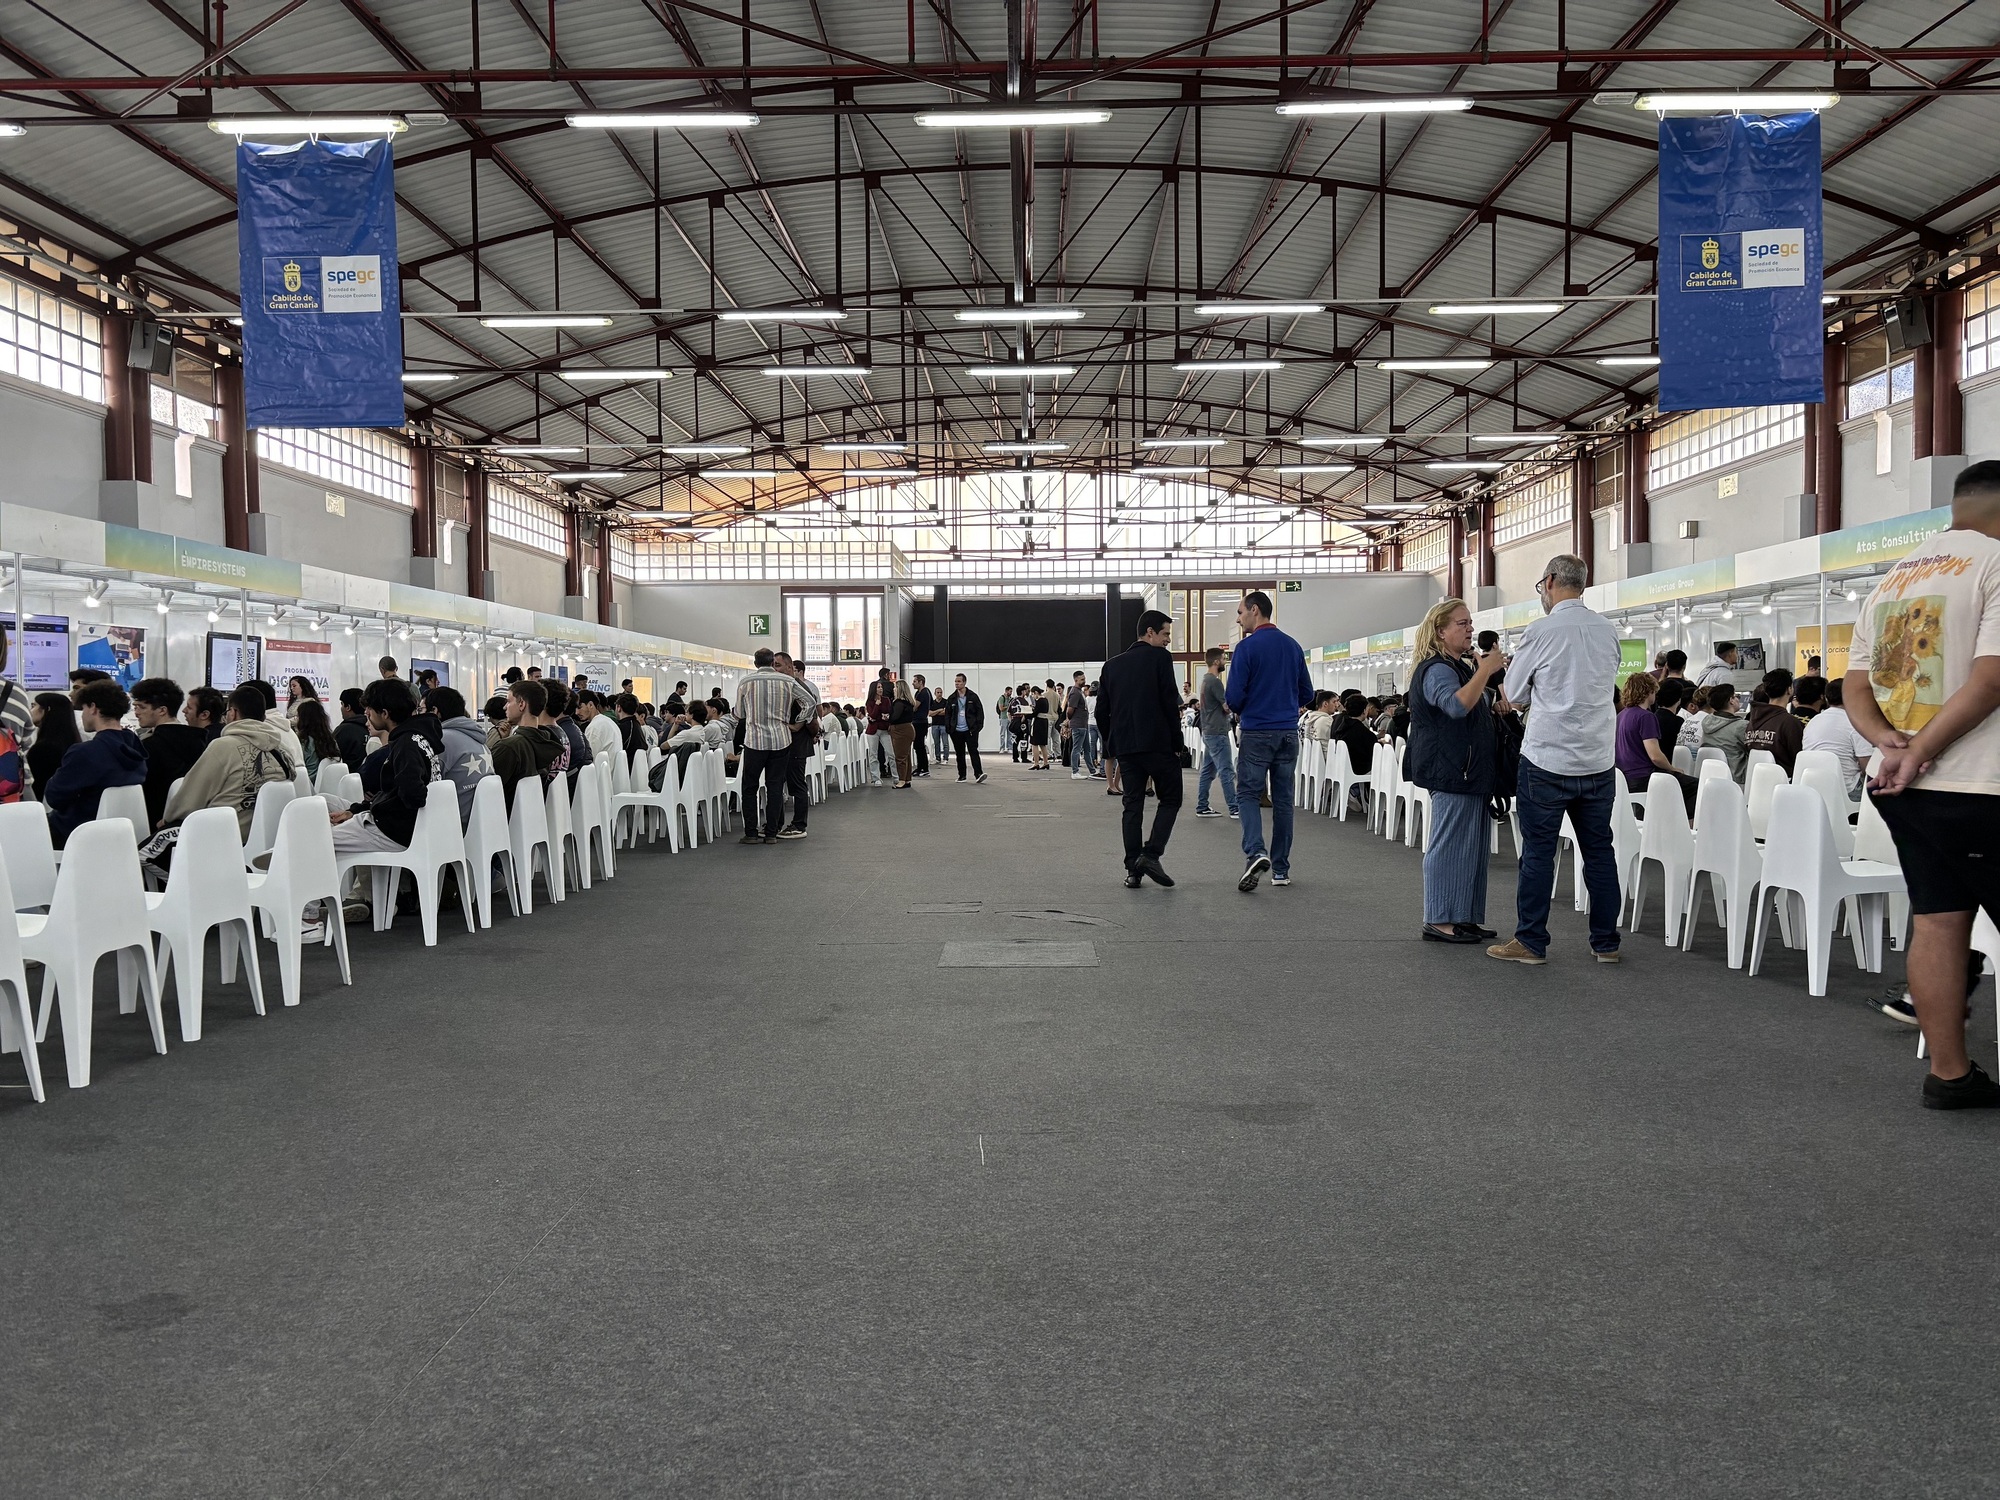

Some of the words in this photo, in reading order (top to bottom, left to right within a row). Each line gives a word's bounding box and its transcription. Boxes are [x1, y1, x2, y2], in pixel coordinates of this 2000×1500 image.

[1748, 243, 1799, 258] spegc
[327, 270, 375, 284] spegc
[1689, 271, 1720, 279] Cabildo
[1721, 270, 1732, 278] de
[1686, 279, 1705, 287] Gran
[1706, 278, 1737, 286] Canaria
[272, 294, 302, 302] Cabildo
[289, 301, 319, 309] Canaria
[1856, 541, 1877, 554] Atos
[181, 555, 246, 578] EMPIRESYSTEMS
[1920, 557, 1934, 567] Van
[1677, 579, 1695, 589] Group
[1816, 645, 1850, 654] vorcios
[589, 684, 611, 692] RING
